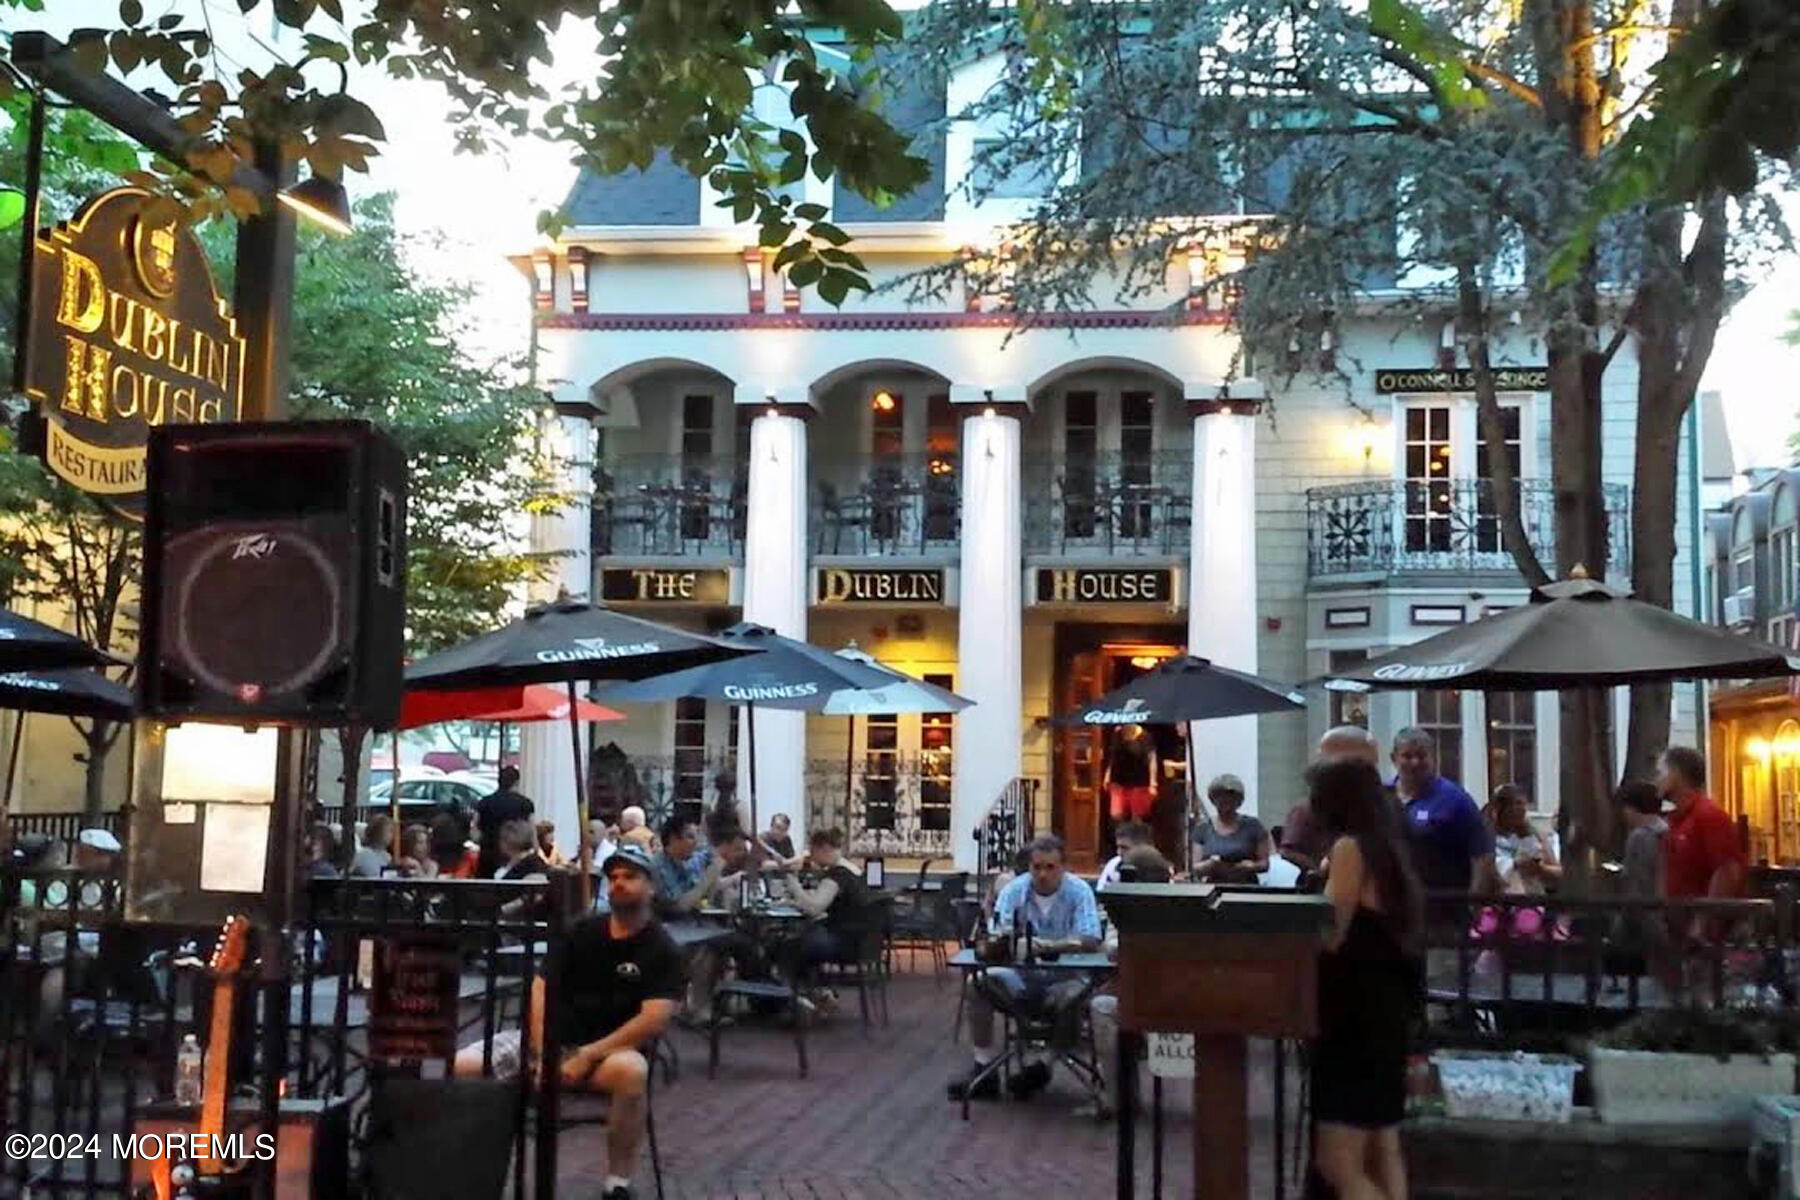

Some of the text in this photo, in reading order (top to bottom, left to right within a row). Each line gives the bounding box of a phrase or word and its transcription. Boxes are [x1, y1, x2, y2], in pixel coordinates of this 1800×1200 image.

[57, 247, 230, 393] DUBLIN
[632, 569, 1157, 603] THE DUBLIN HOUSE
[537, 641, 661, 663] GUINNESS
[724, 681, 818, 700] GUINNESS
